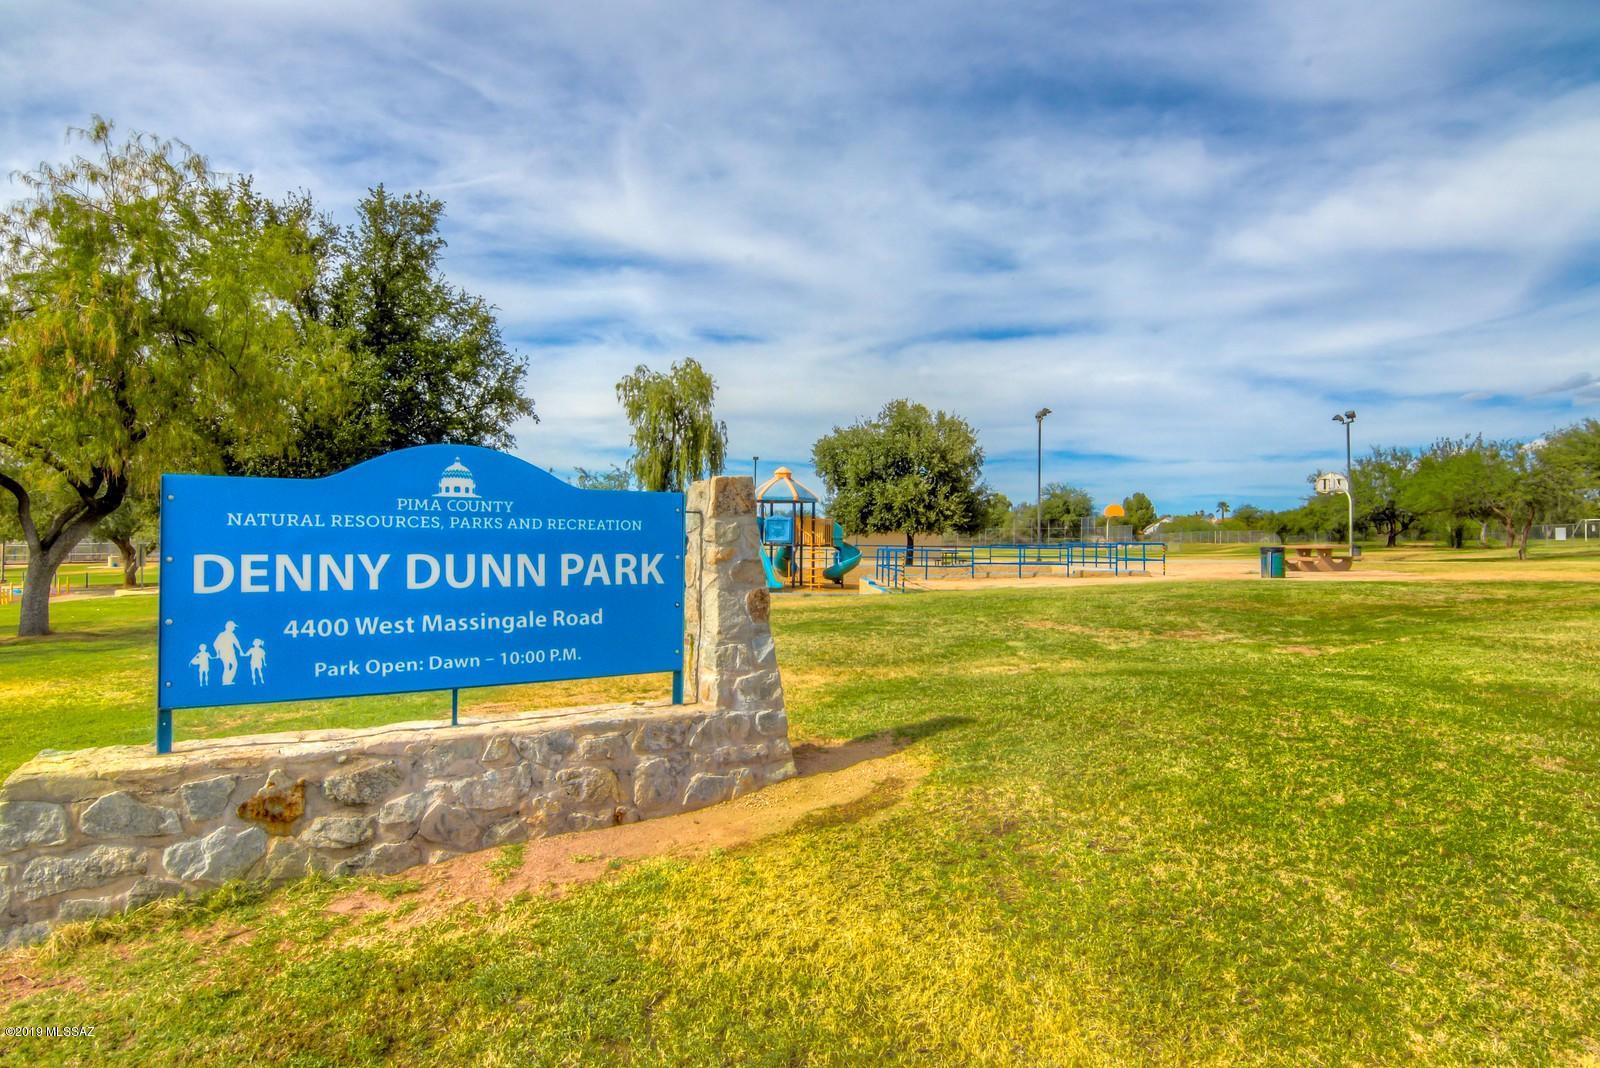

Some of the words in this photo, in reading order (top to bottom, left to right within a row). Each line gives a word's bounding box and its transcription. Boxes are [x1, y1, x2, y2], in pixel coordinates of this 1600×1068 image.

[397, 498, 441, 511] PIMA
[447, 500, 513, 513] COUNTY
[227, 513, 325, 526] NATURAL
[331, 514, 445, 530] RESOURCES,
[450, 517, 502, 528] PARKS
[508, 518, 542, 529] AND
[548, 519, 641, 530] RECREATION
[193, 554, 390, 594] DENNY
[407, 554, 545, 589] DUNN
[561, 553, 664, 586] PARK
[284, 618, 348, 638] 4400
[355, 617, 414, 635] West
[422, 611, 547, 633] Massingale
[552, 607, 604, 626] Road
[315, 660, 359, 677] Park
[366, 660, 423, 677] Open:
[429, 656, 480, 670] Dawn
[500, 649, 546, 665] 10:00
[550, 647, 582, 662] P.M.
